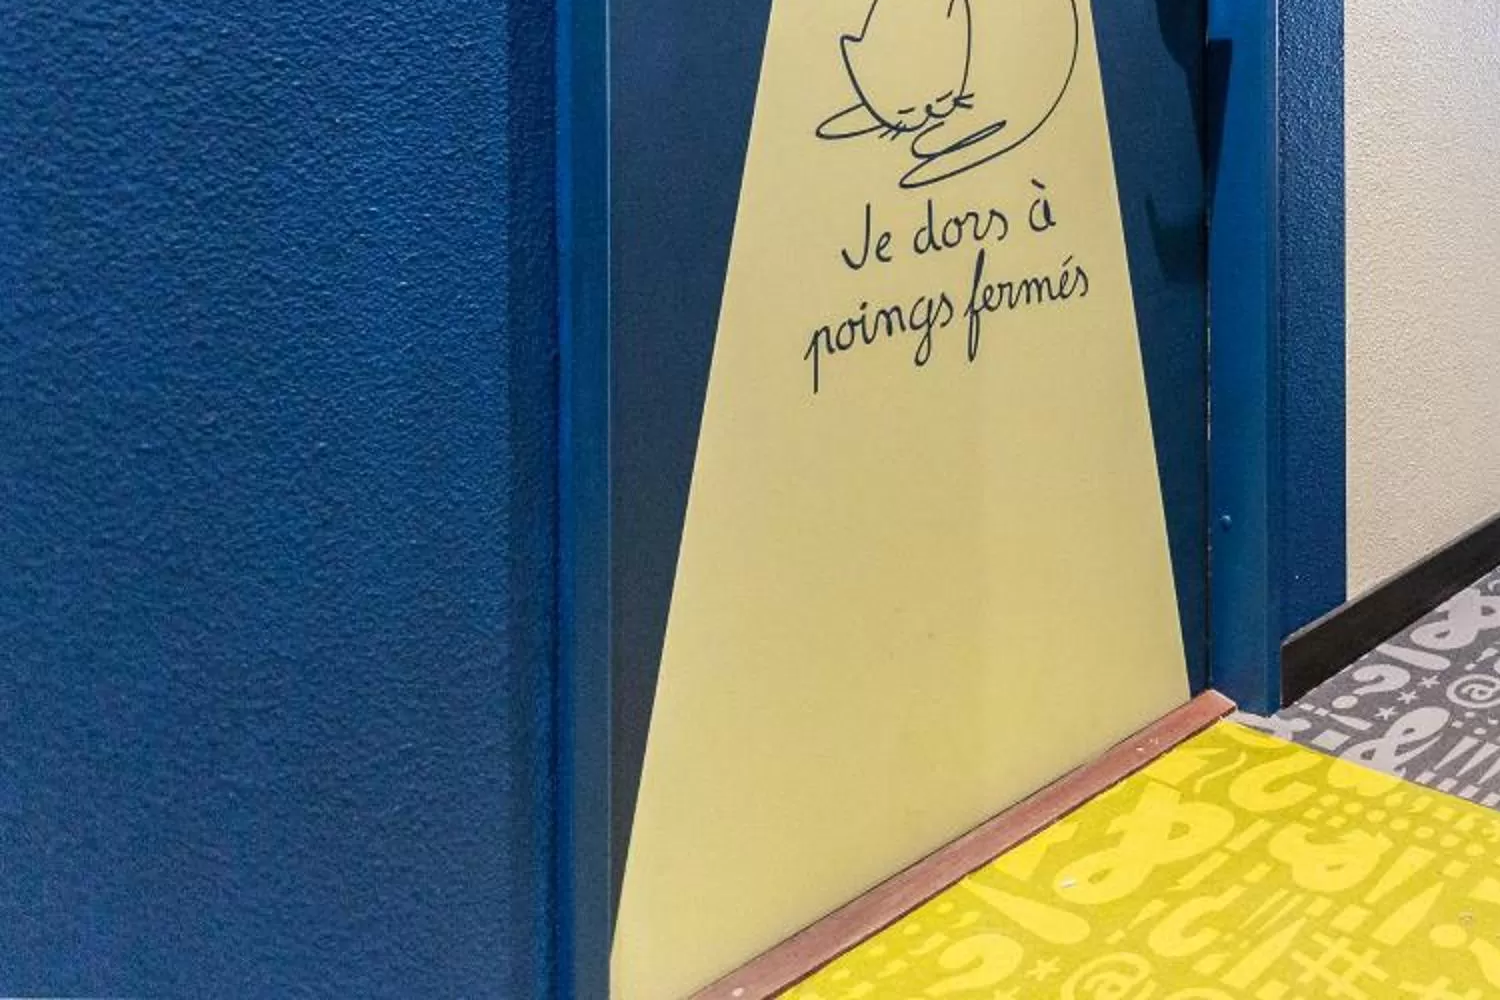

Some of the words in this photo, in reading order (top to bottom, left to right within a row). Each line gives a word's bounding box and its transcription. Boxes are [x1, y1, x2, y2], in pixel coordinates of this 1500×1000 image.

[841, 203, 893, 270] Je
[912, 199, 1009, 255] dors
[1027, 179, 1057, 232] à
[803, 293, 954, 394] poings
[964, 248, 1090, 362] fermés
